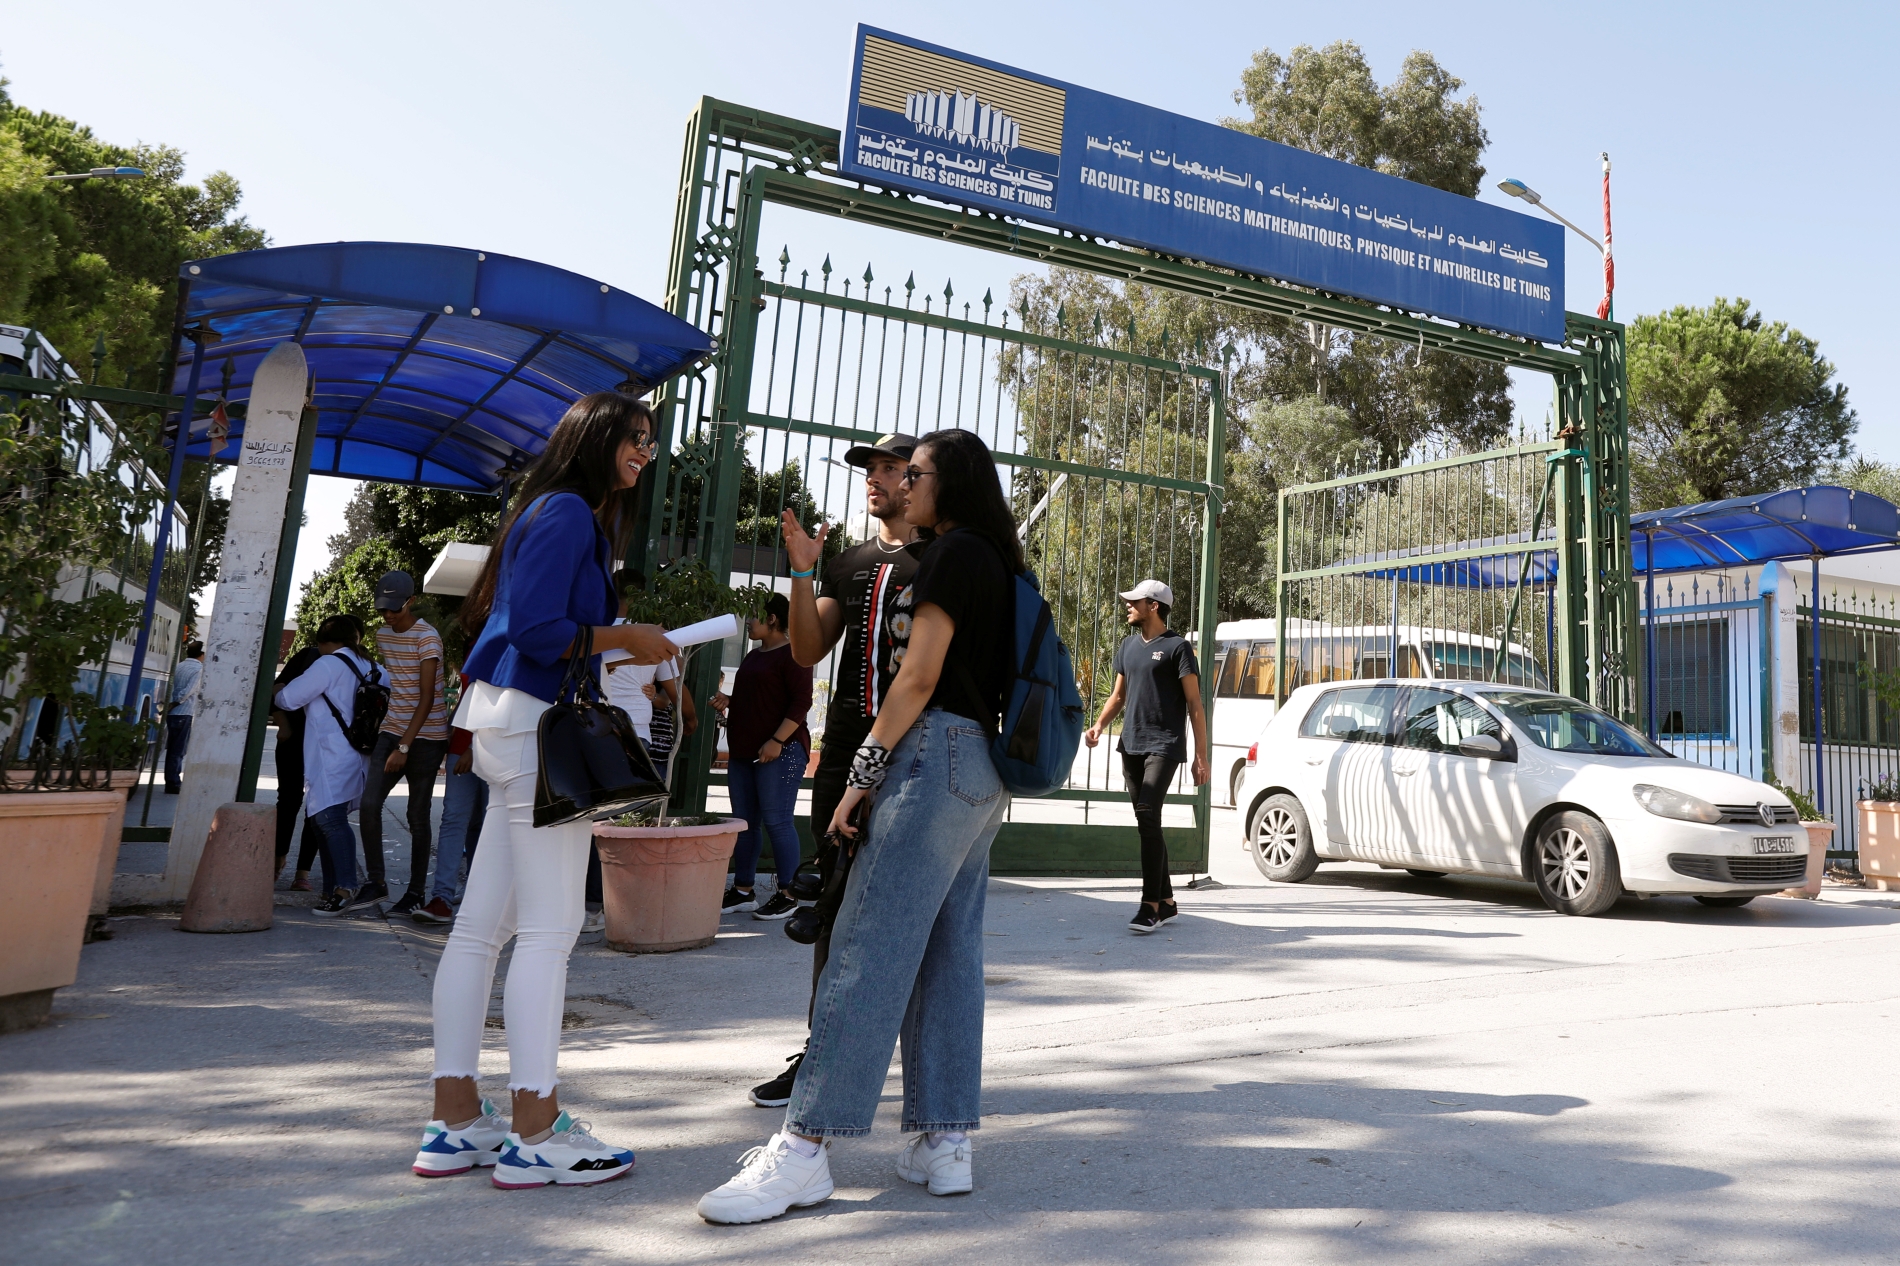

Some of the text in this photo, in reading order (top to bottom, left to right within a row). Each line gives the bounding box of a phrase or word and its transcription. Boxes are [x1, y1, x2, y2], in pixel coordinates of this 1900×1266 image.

[858, 134, 1054, 192] كلية العلوم بتونس
[1086, 135, 1144, 163] بتونس
[857, 149, 1053, 209] FACULTE DES SCIENCES DE TUNIS
[1080, 166, 1551, 302] FACULTE DES SCIENCES MATHEMATIQUES, PHYSIQUE ET NATURELLES DE TUNIS
[1354, 204, 1443, 241] للرياضيات
[1448, 233, 1496, 255] العلوم
[1499, 243, 1549, 269] كلية
